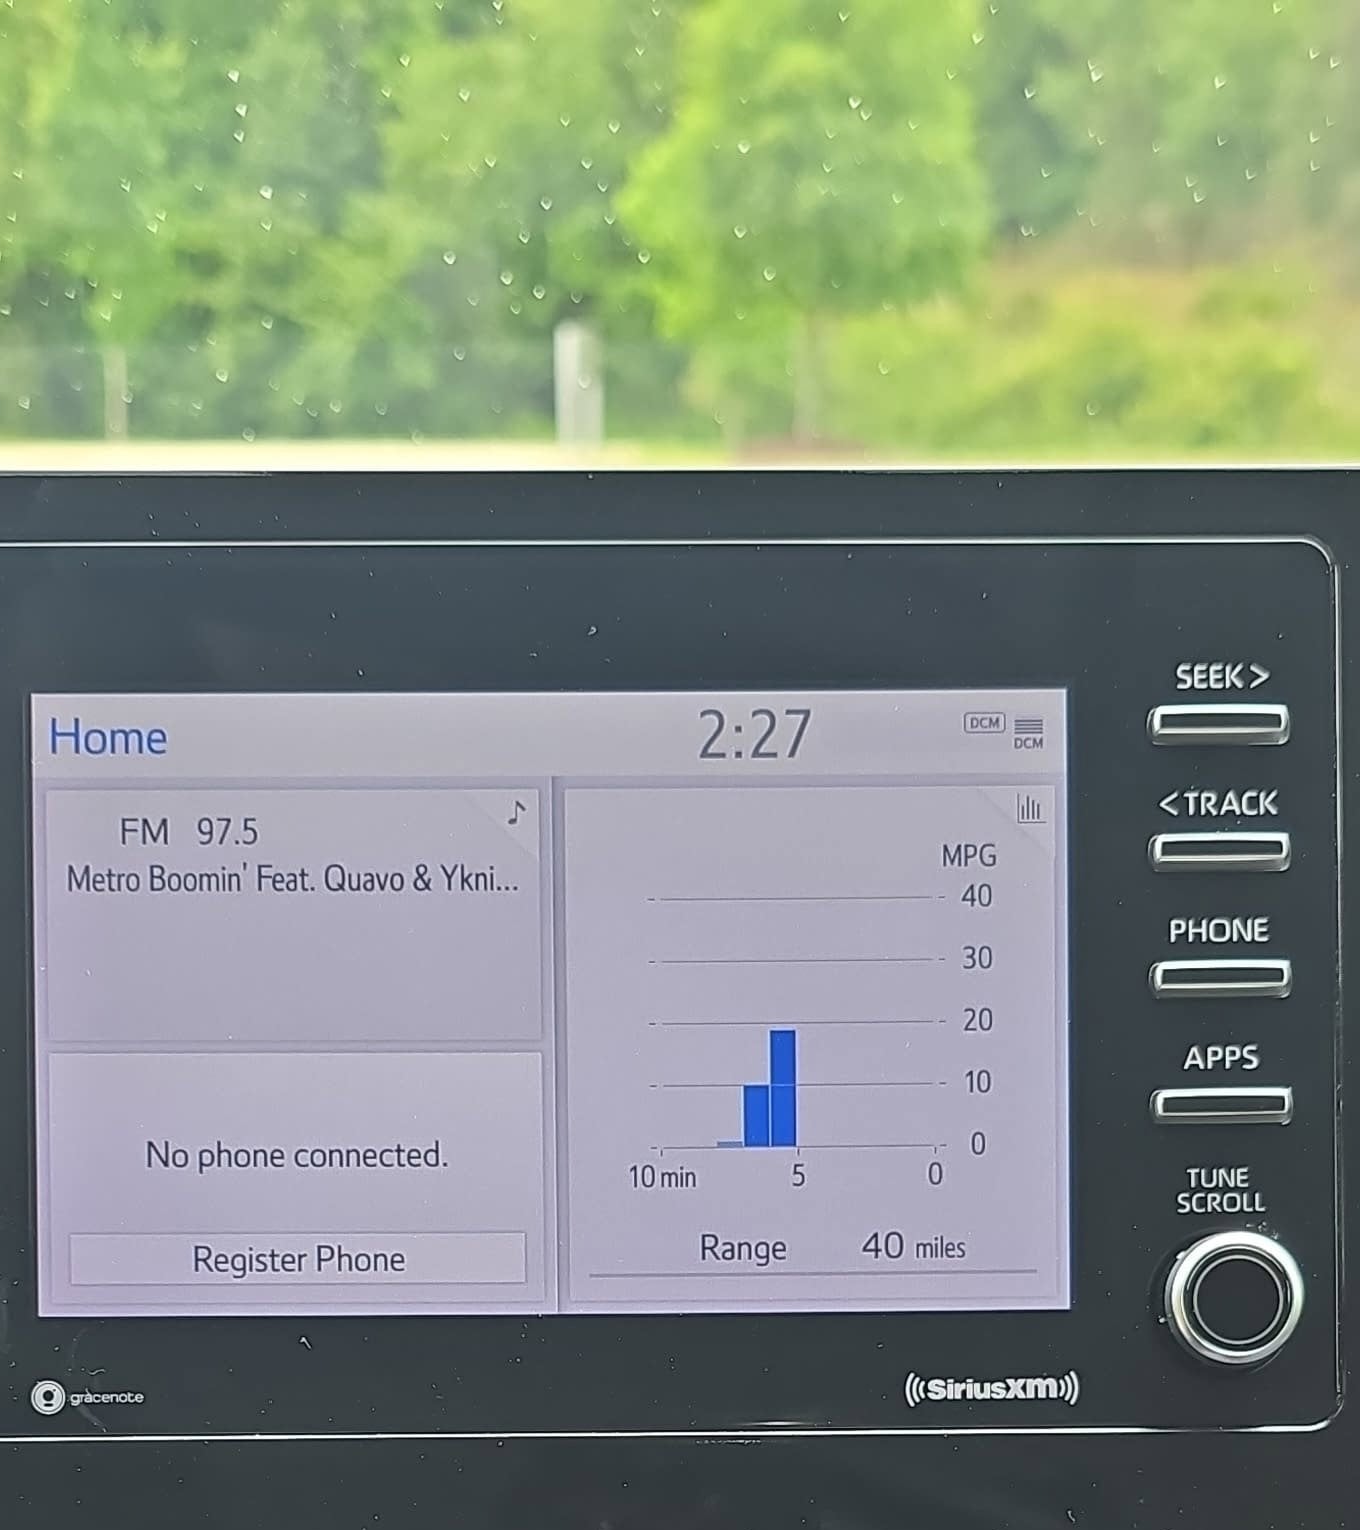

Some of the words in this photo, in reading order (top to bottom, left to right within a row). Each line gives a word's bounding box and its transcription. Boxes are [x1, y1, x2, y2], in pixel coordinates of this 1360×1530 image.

[51, 717, 167, 755] Home
[699, 708, 811, 759] 2:27
[969, 716, 1000, 731] DCM
[1014, 737, 1044, 750] DCM
[121, 817, 169, 845] FM
[197, 817, 258, 846] 97.5
[942, 843, 997, 867] MPG
[68, 864, 141, 893] Metro
[149, 861, 247, 892] Boomin'
[257, 864, 316, 892] Feat.
[324, 863, 405, 893] Quavo
[412, 863, 432, 892] &
[440, 863, 518, 892] Ykni...
[961, 883, 992, 908] 40
[1170, 917, 1269, 943] PHONE
[962, 945, 993, 970] 30
[963, 1007, 993, 1032] 20
[1183, 1044, 1259, 1070] APPS
[965, 1069, 991, 1094] 10
[147, 1140, 189, 1168] No
[198, 1140, 285, 1173] phone
[294, 1139, 448, 1168] connected.
[971, 1131, 986, 1156] 0
[629, 1164, 656, 1188] 10
[660, 1166, 697, 1188] min
[792, 1163, 805, 1187] 5
[928, 1161, 943, 1186] 0
[1186, 1168, 1249, 1188] TUNE
[1177, 1192, 1266, 1214] SCROLL
[194, 1245, 307, 1279] Register
[316, 1244, 405, 1272] Phone
[701, 1233, 787, 1267] Range
[862, 1231, 904, 1260] 40
[916, 1235, 966, 1260] miles
[69, 1389, 145, 1407] gracenote
